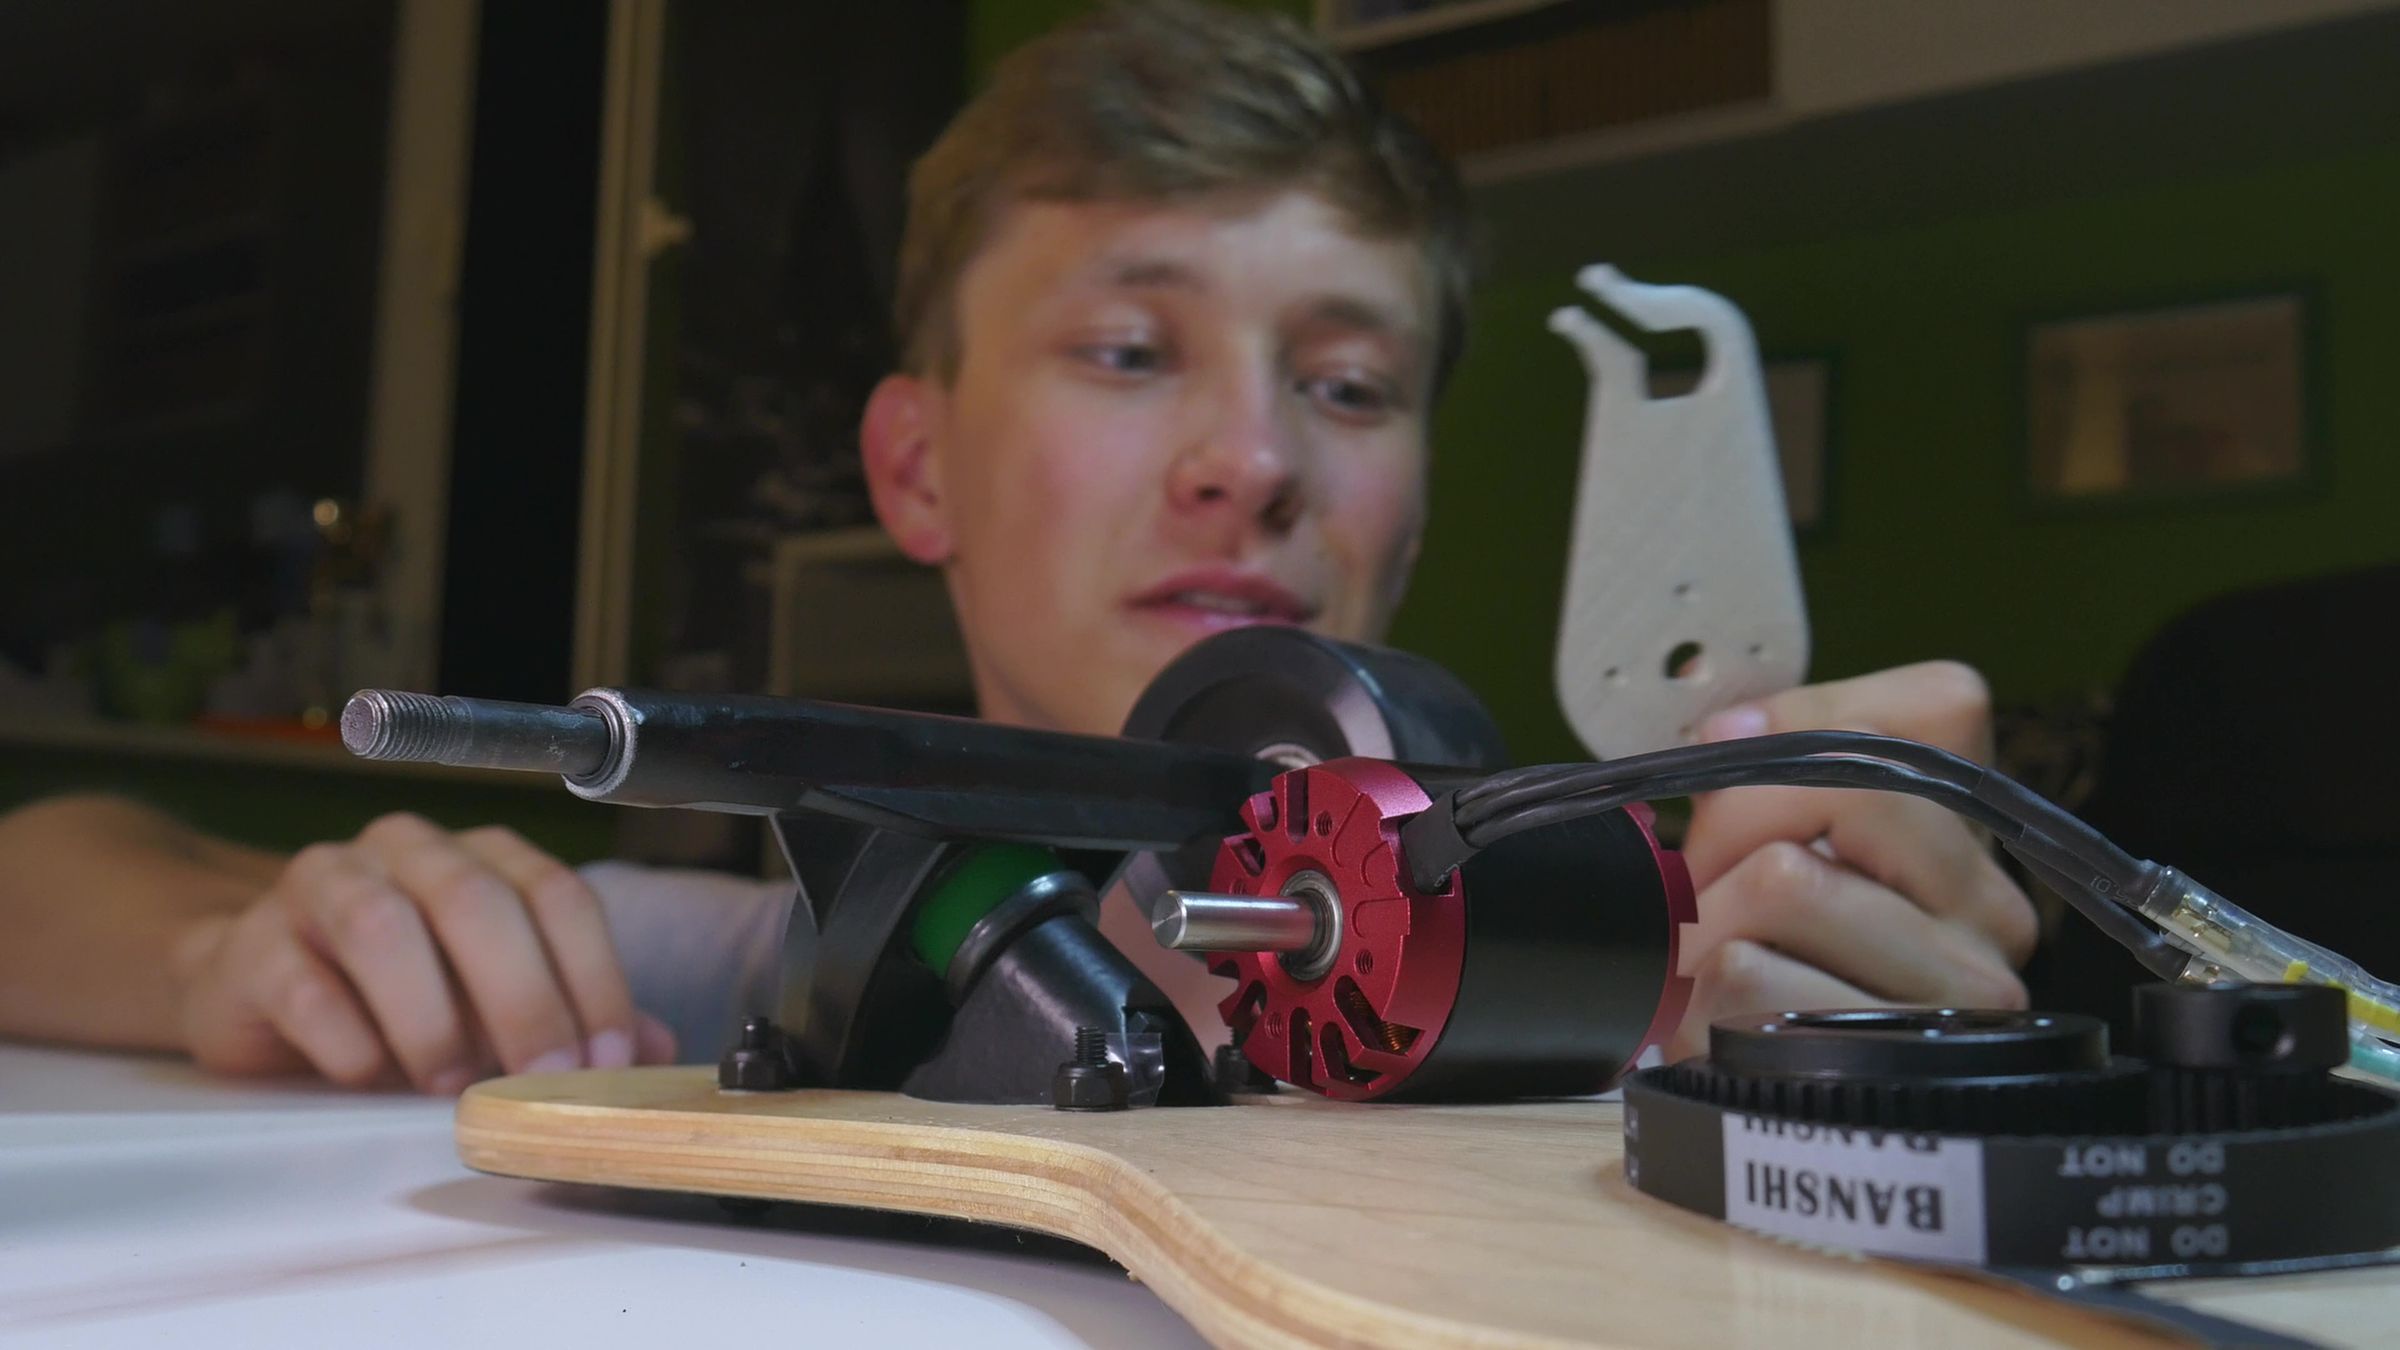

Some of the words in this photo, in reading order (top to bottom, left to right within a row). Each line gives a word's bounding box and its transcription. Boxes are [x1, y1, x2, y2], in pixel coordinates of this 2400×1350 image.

[2057, 1142, 2147, 1179] NOT
[2166, 1141, 2227, 1177] DO
[1746, 1161, 1943, 1231] BANSHI
[2096, 1181, 2229, 1219] CRIMP
[2061, 1225, 2151, 1260] NOT
[2169, 1223, 2230, 1259] DO
